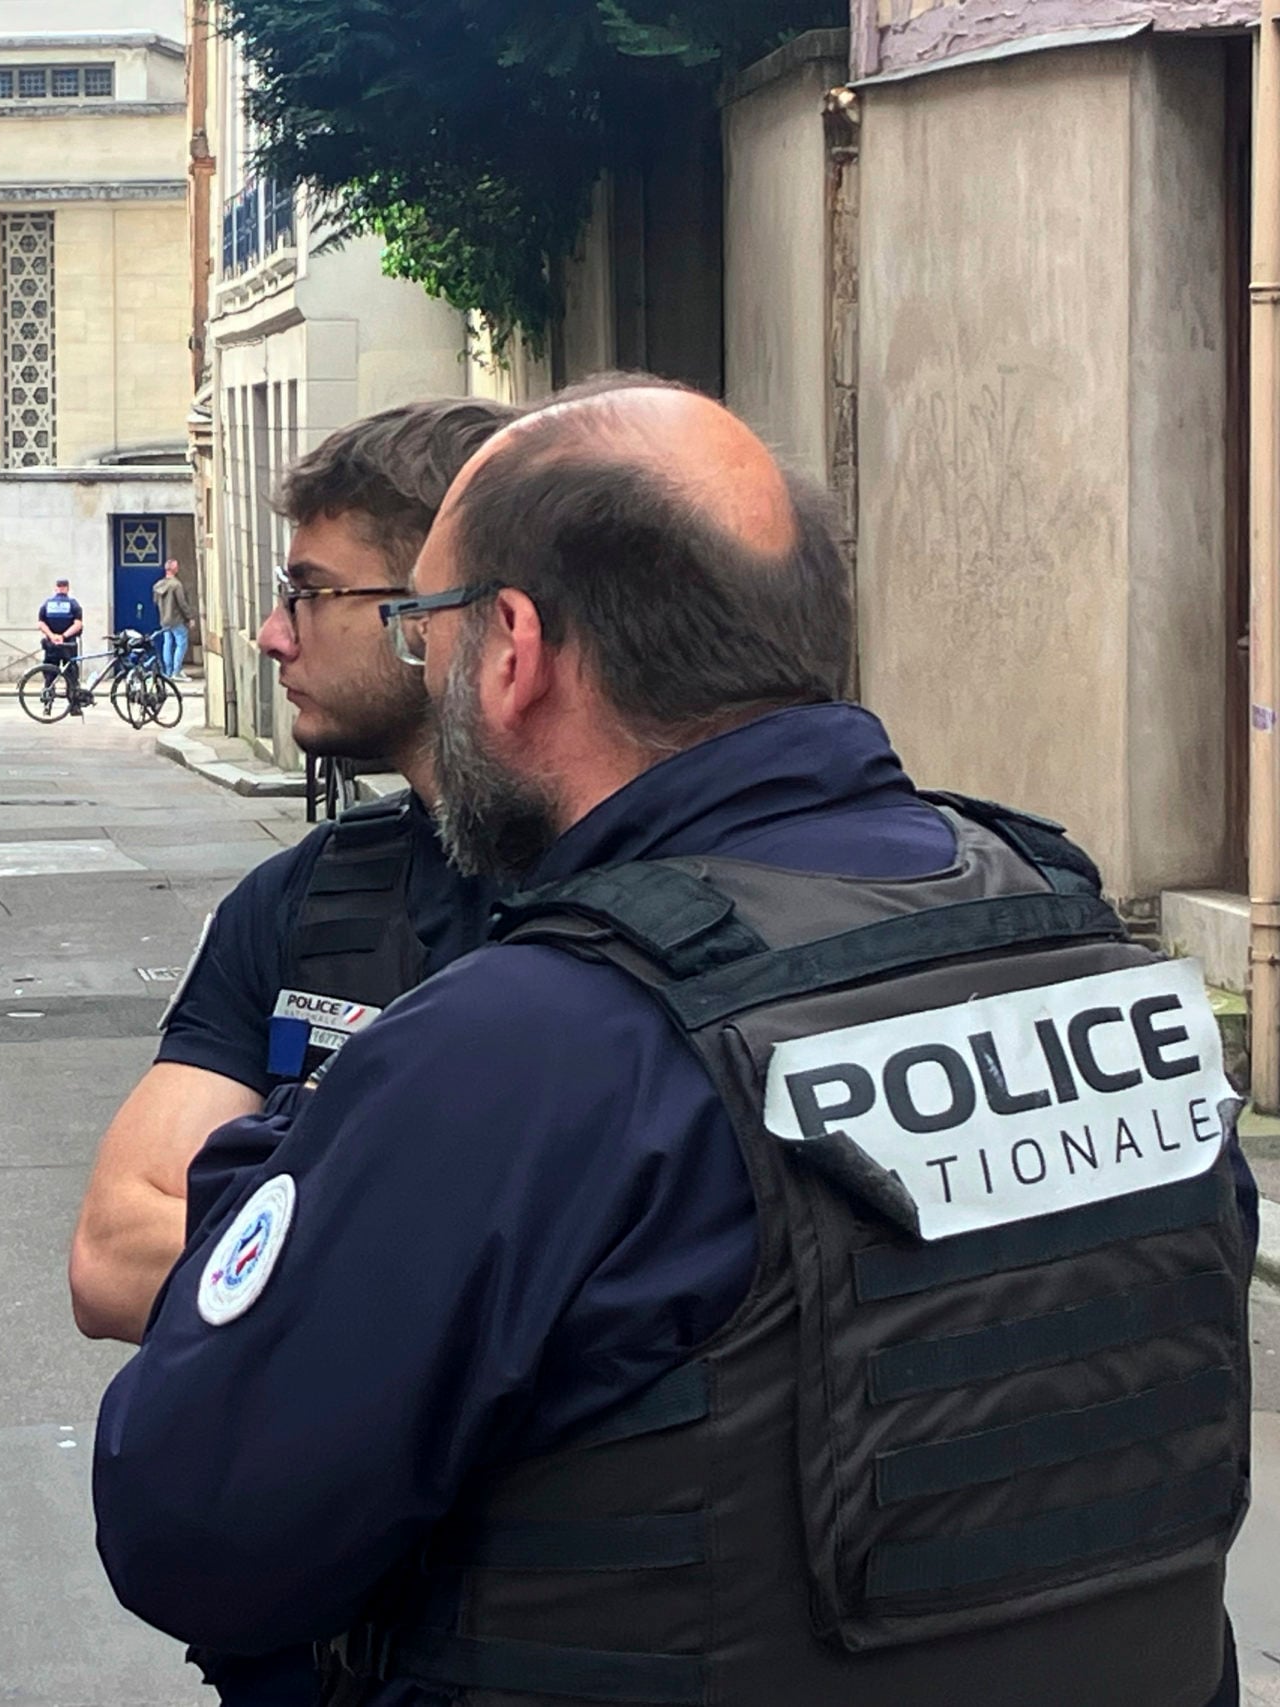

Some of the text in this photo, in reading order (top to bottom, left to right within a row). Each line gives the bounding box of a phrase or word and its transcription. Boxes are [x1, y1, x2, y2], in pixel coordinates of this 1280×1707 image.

[287, 994, 342, 1016] POLICE
[785, 994, 1201, 1139] POLICE
[890, 1098, 1220, 1203] TIONALE
